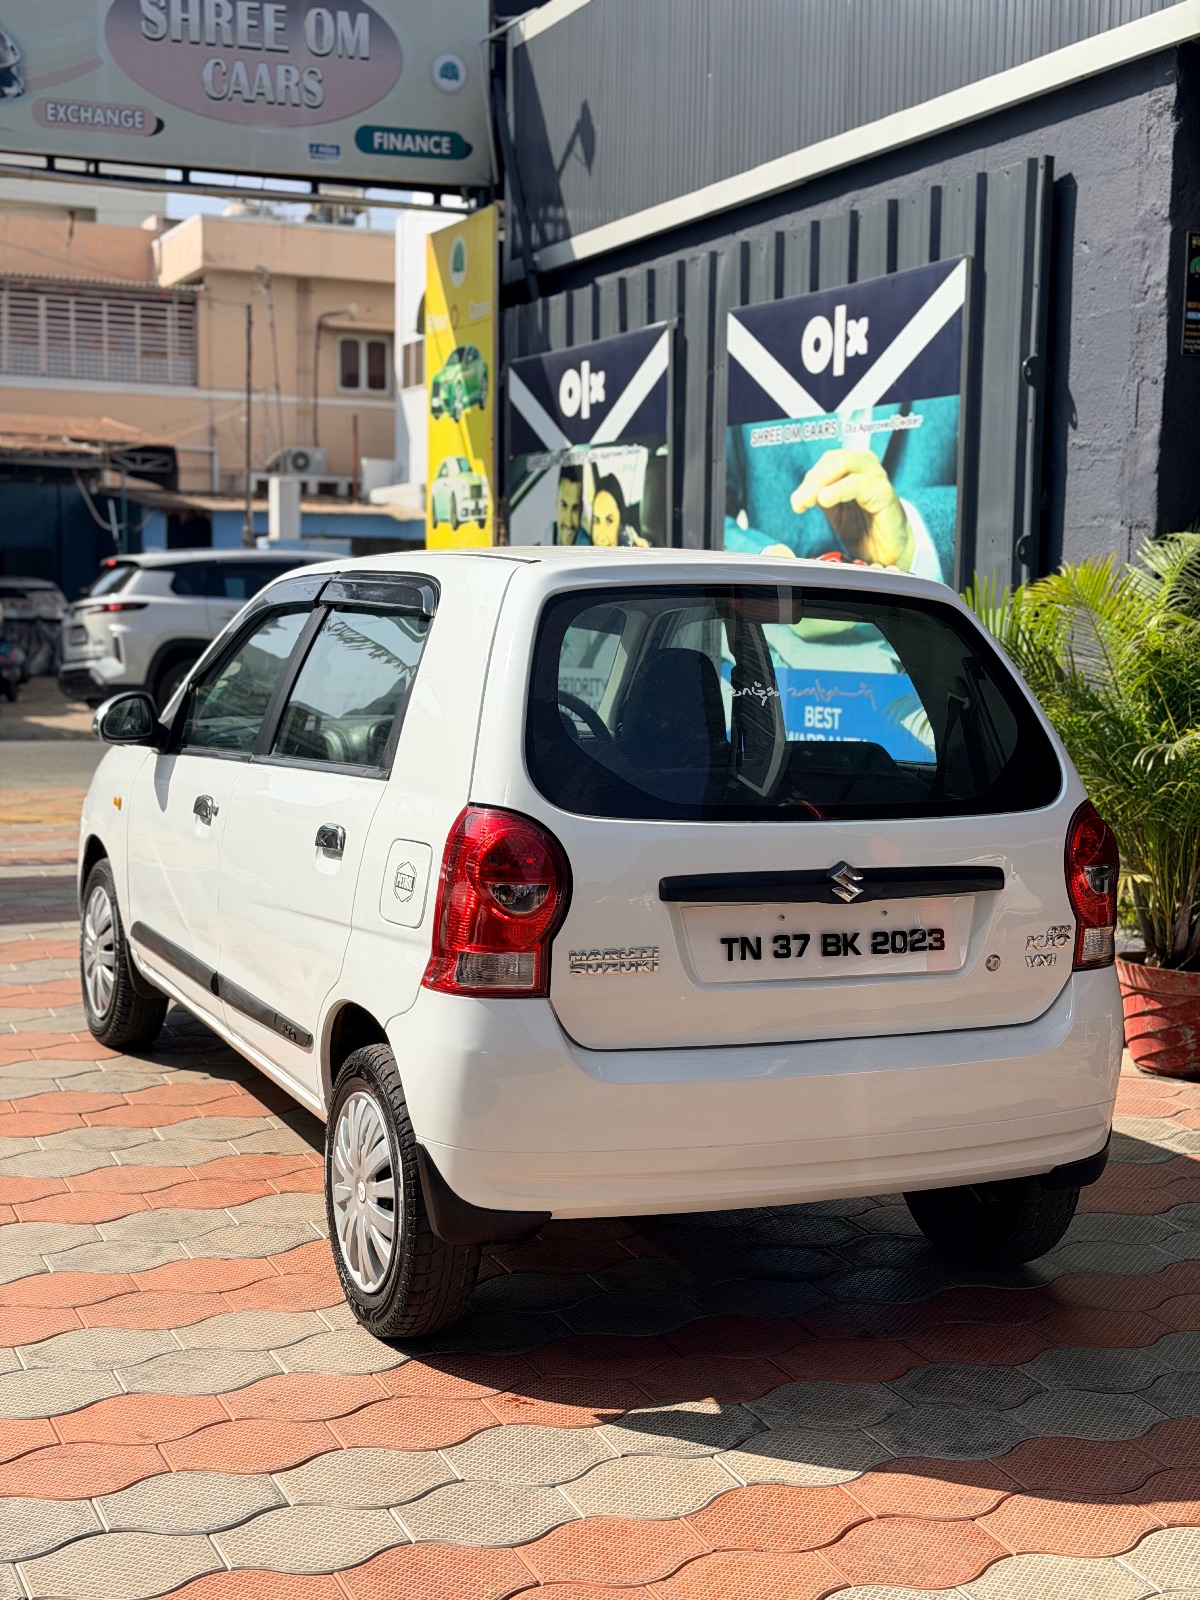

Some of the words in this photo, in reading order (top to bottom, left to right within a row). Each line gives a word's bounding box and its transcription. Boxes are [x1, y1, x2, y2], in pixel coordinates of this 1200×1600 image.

[139, 0, 290, 54] SHREE
[304, 6, 372, 61] OM
[202, 57, 325, 109] CAARS
[46, 103, 145, 129] EXCHANGE
[372, 131, 452, 155] FINANCE
[752, 427, 782, 446] SHREE
[803, 420, 837, 440] CAARS
[804, 705, 842, 730] BEST
[569, 946, 660, 961] MARUTI
[720, 936, 763, 962] TN
[772, 934, 811, 959] 37
[821, 932, 863, 957] BK
[870, 927, 945, 955] 2023
[570, 961, 660, 977] SUZUKI
